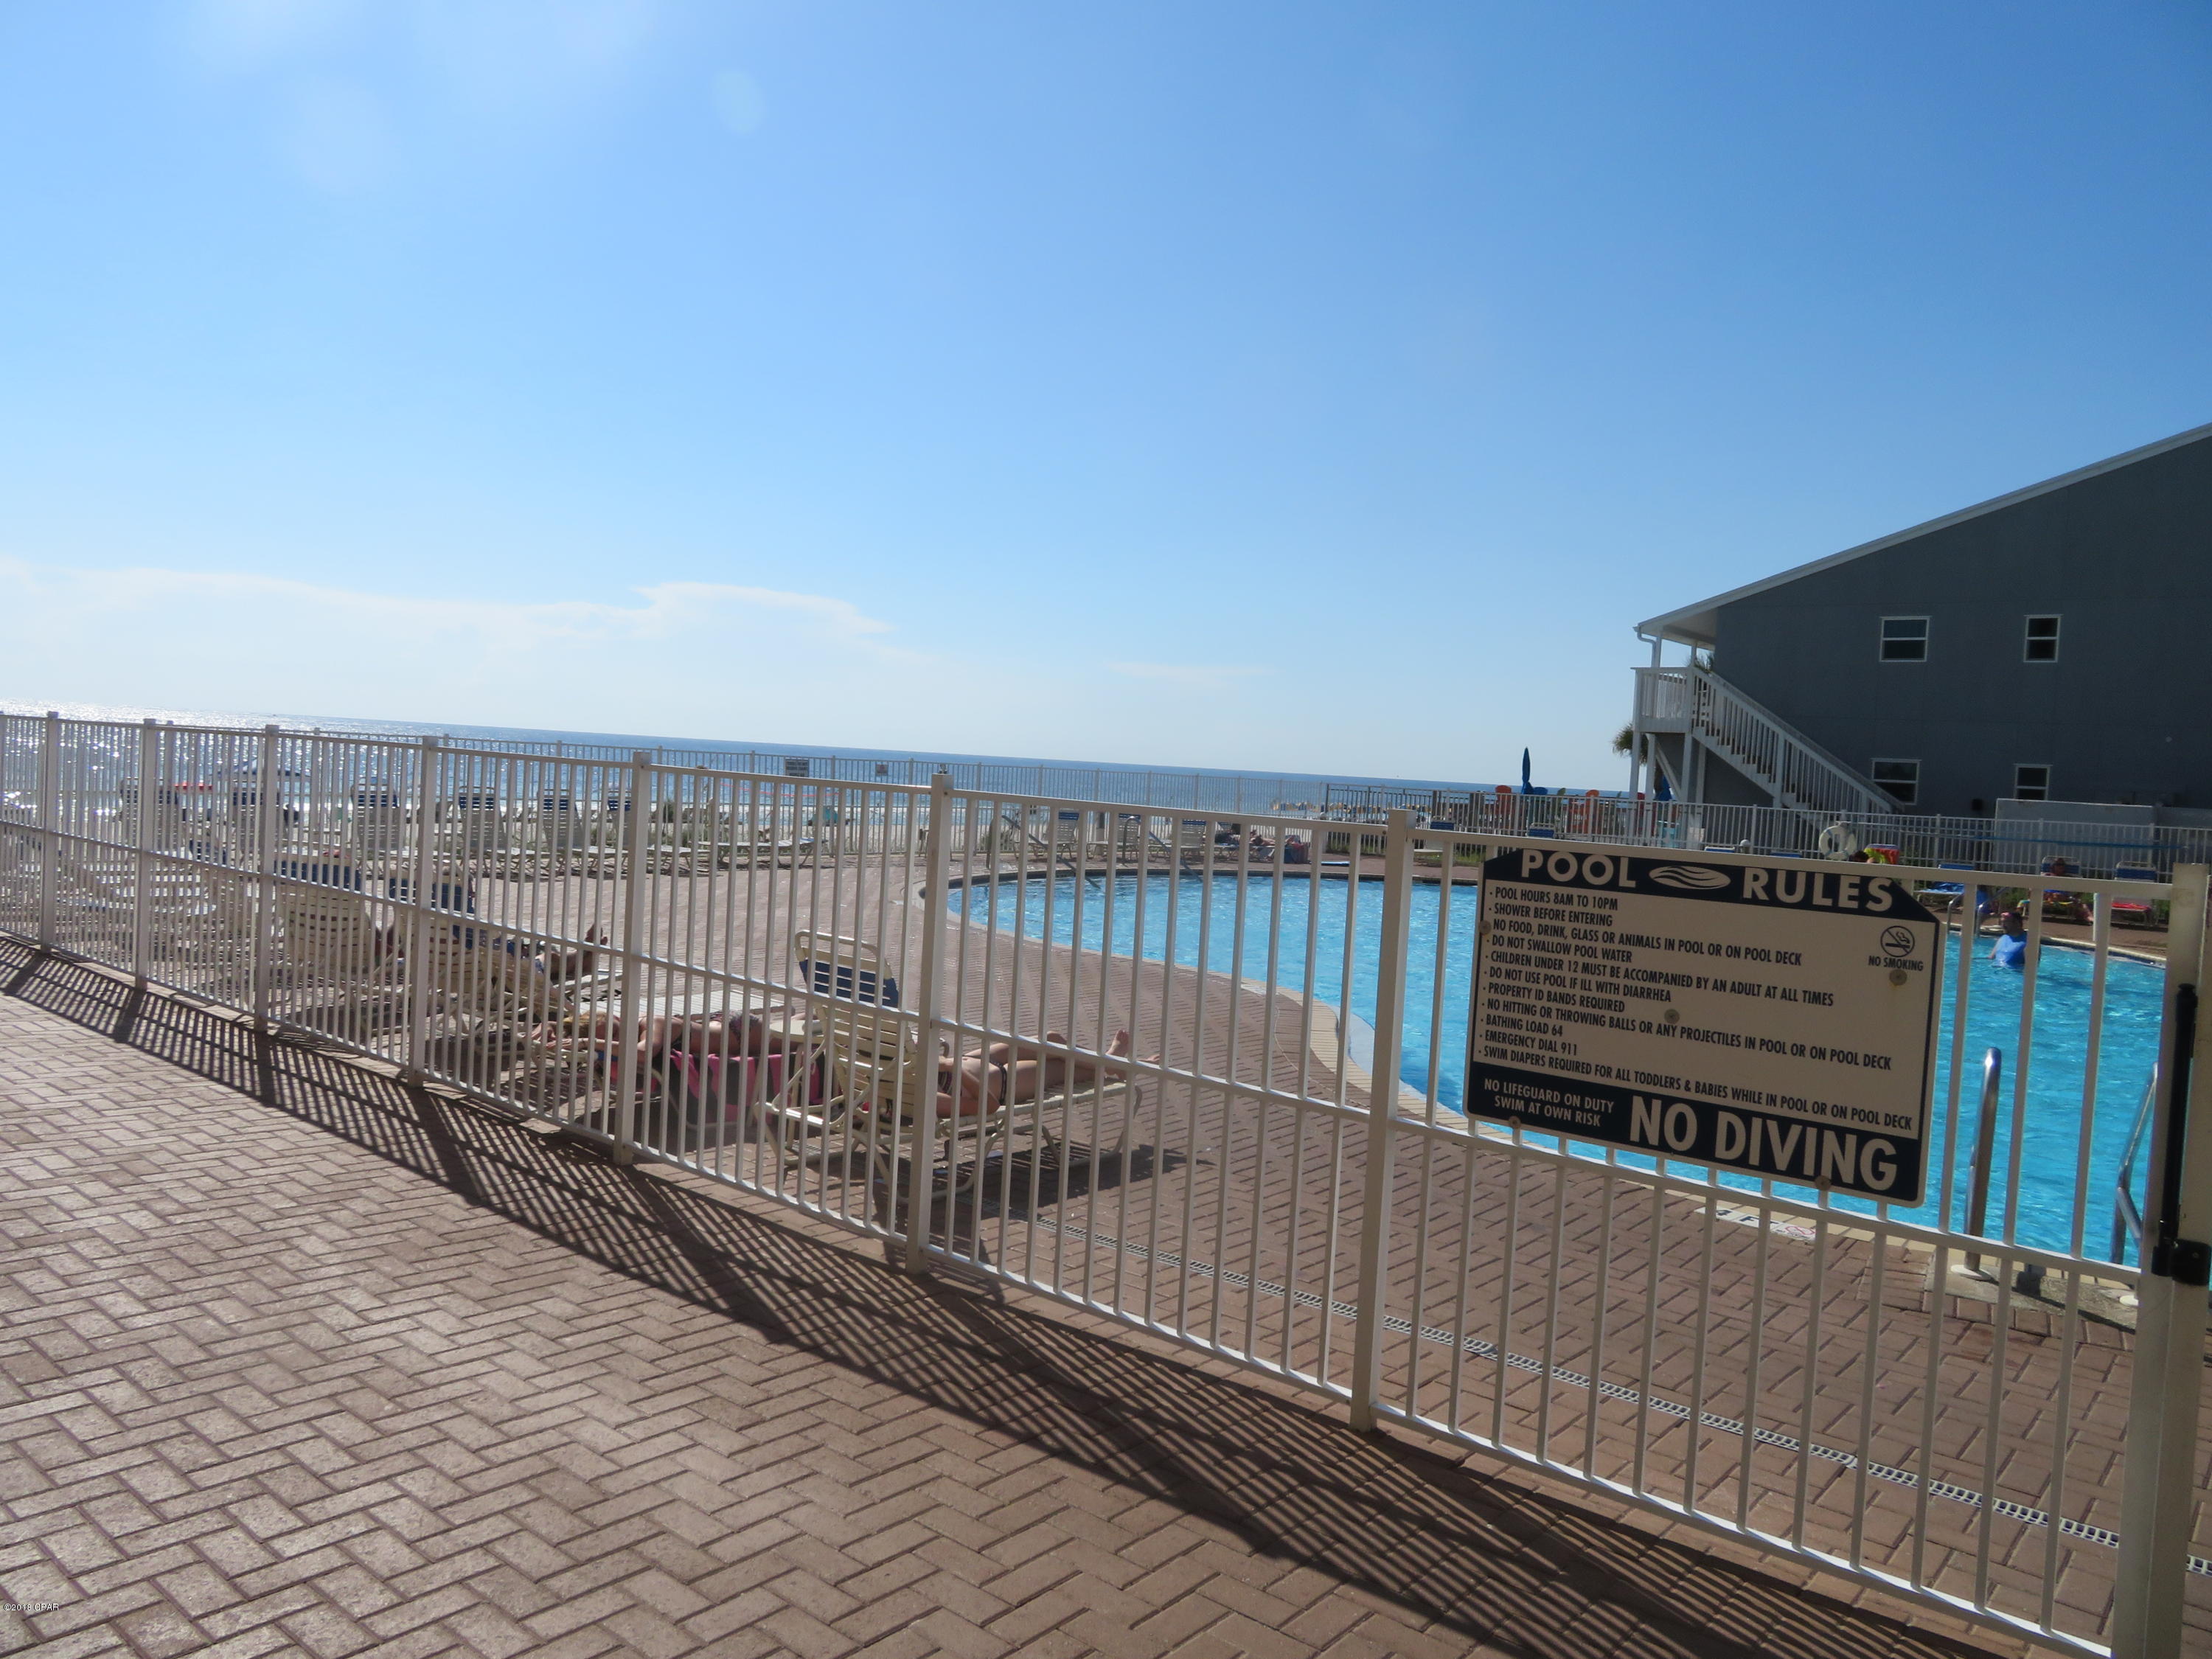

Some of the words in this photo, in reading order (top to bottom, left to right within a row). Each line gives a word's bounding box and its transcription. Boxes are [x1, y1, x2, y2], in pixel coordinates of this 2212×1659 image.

[1521, 849, 1636, 888] POOL
[1742, 867, 1893, 911] RULES
[1494, 902, 1531, 917] SHOWER
[1533, 906, 1566, 922] BEFORE
[1568, 910, 1613, 927] ENTERING
[1495, 886, 1517, 900] POOL
[1520, 888, 1551, 903] HOURS
[1553, 892, 1573, 905] 8AM
[1576, 894, 1588, 908] TO
[1593, 896, 1618, 911] 10PM
[1492, 934, 1504, 947] DO
[1506, 936, 1525, 949] NOT
[1527, 938, 1571, 955] SWALLOW
[1573, 944, 1598, 959] POOL
[1601, 947, 1632, 963] WATER
[1493, 918, 1506, 931] NO
[1571, 927, 1599, 942] GLASS
[1601, 931, 1615, 944] OR
[1618, 933, 1661, 949] ANIMALS
[1664, 937, 1675, 951] IN
[1677, 939, 1704, 955] POOL
[1707, 942, 1722, 956] OR
[1725, 945, 1741, 959] ON
[1744, 947, 1772, 962] POOL
[1775, 950, 1801, 966] DECK
[1491, 950, 1531, 967] CHILDREN
[1534, 956, 1564, 971] UNDER
[1568, 960, 1579, 973] 12
[1581, 961, 1607, 976] MUST
[1610, 965, 1621, 978] BE
[1623, 967, 1693, 987] ACCOMPANIED
[1696, 976, 1709, 990] BY
[1711, 978, 1727, 992] AN
[1729, 981, 1762, 997] ADULT
[1764, 985, 1778, 999] AT
[1780, 987, 1798, 1002] ALL
[1802, 990, 1833, 1006] TIMES
[1868, 955, 1881, 967] NO
[1883, 957, 1924, 971] SMOKING
[1488, 981, 1532, 999] PROPERTY
[1534, 988, 1544, 1001] ID
[1546, 990, 1576, 1006] BANDS
[1579, 995, 1625, 1012] REQUIRED
[1489, 966, 1502, 978] DO
[1504, 968, 1523, 981] NOT
[1525, 970, 1541, 984] USE
[1543, 973, 1567, 988] POOL
[1569, 977, 1578, 990] IF
[1580, 978, 1592, 992] ILL
[1595, 980, 1620, 995] WITH
[1623, 984, 1671, 1002] DIARRHEA
[1486, 1013, 1523, 1030] BATHING
[1526, 1020, 1549, 1034] LOAD
[1551, 1024, 1562, 1037] 64
[1487, 998, 1500, 1011] NO
[1502, 1000, 1537, 1016] HITTING
[1539, 1006, 1552, 1019] OR
[1555, 1008, 1606, 1027] THROWING
[1609, 1016, 1635, 1032] BALLS
[1638, 1020, 1653, 1034] OR
[1655, 1023, 1677, 1037] ANY
[1680, 1026, 1741, 1047] PROJECTILES
[1745, 1036, 1756, 1049] IN
[1759, 1038, 1787, 1054] POOL
[1790, 1043, 1806, 1057] OR
[1809, 1046, 1826, 1060] ON
[1829, 1048, 1860, 1065] POOL
[1863, 1054, 1891, 1070] DECK
[1485, 1029, 1536, 1048] EMERGENCY
[1538, 1038, 1558, 1052] DIAL
[1561, 1041, 1576, 1056] 911
[1484, 1045, 1508, 1060] SWIM
[1510, 1049, 1545, 1067] DIAPERS
[1548, 1056, 1592, 1075] REQUIRED
[1594, 1064, 1613, 1079] FOR
[1615, 1068, 1631, 1082] ALL
[1634, 1071, 1681, 1090] TODDLERS
[1694, 1080, 1728, 1099] BABIES
[1731, 1087, 1762, 1105] WHILE
[1765, 1093, 1777, 1107] IN
[1780, 1095, 1808, 1113] POOL
[1812, 1101, 1827, 1116] OR
[1830, 1104, 1847, 1119] ON
[1851, 1107, 1880, 1125] POOL
[1884, 1113, 1912, 1130] DECK
[1484, 1078, 1500, 1091] NO
[1503, 1082, 1560, 1103] LIFEGUARD
[1564, 1093, 1581, 1107] ON
[1584, 1096, 1614, 1113] DUTY
[1495, 1095, 1524, 1112] SWIM
[1528, 1102, 1541, 1114] AT
[1544, 1105, 1571, 1121] OWN
[1575, 1110, 1600, 1127] RISK
[1630, 1095, 1697, 1151] NO
[1714, 1110, 1897, 1191] DIVING
